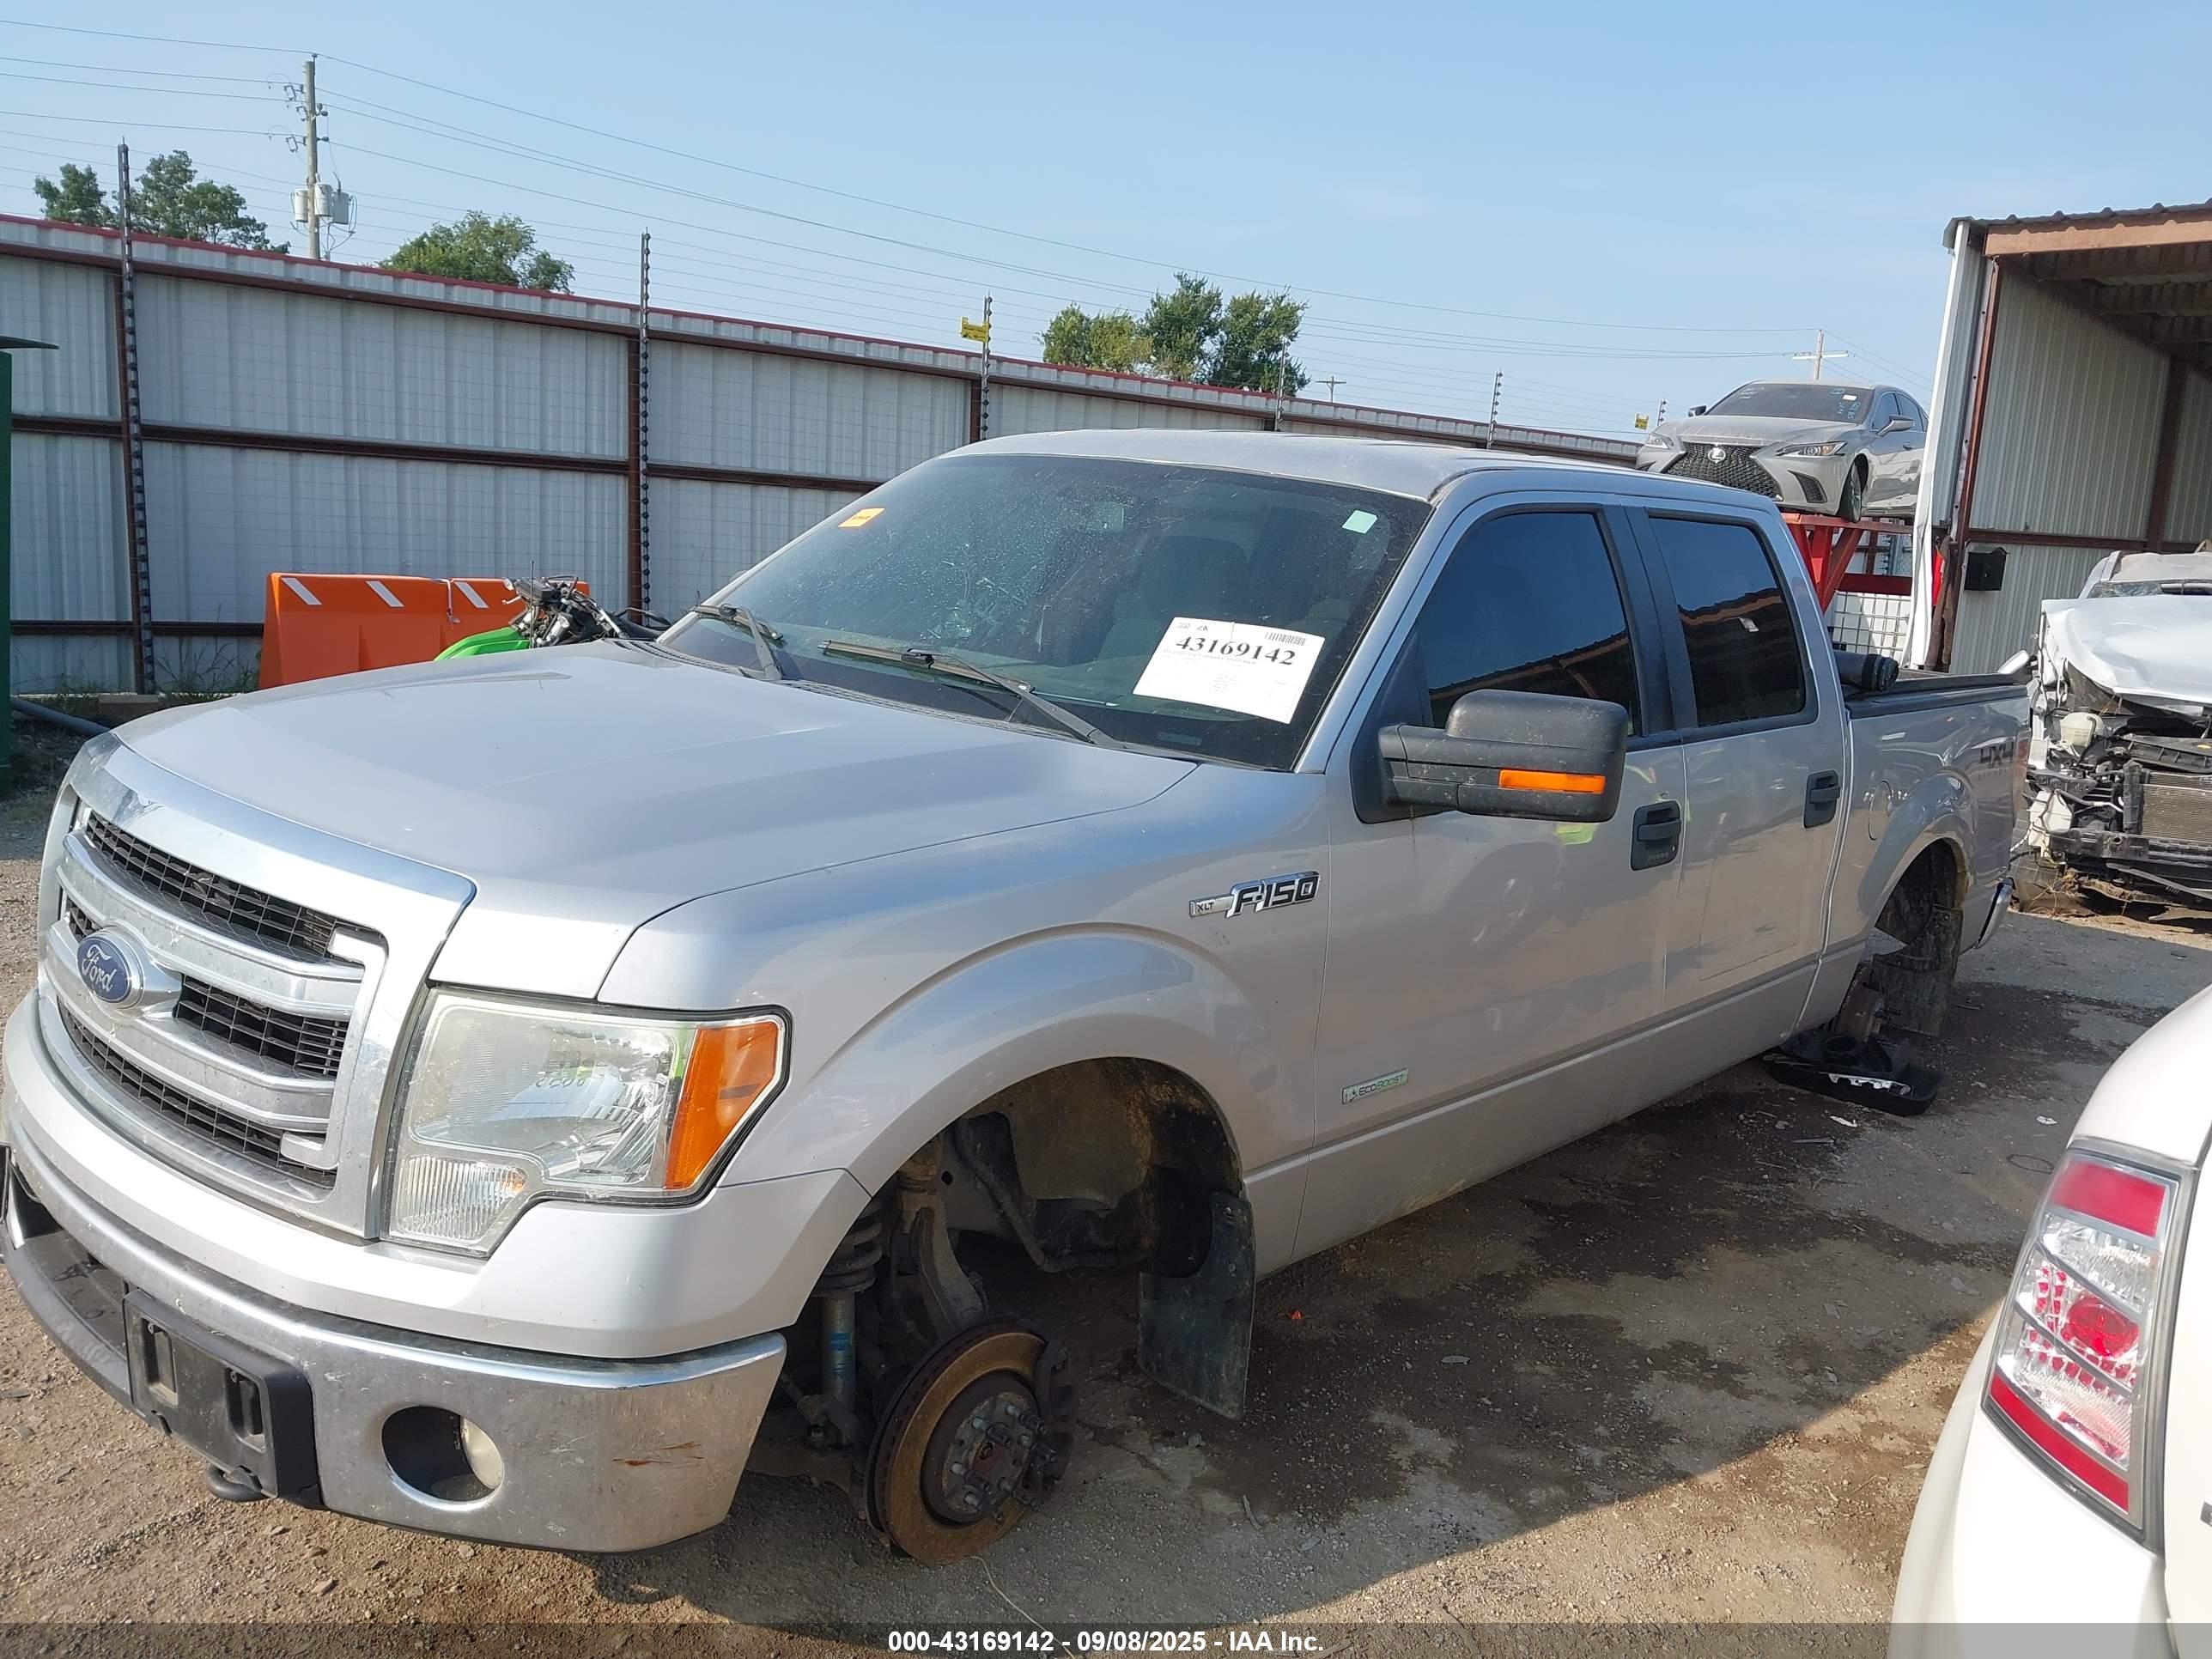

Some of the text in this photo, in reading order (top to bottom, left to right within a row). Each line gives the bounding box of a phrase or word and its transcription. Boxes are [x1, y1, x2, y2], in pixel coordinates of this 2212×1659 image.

[1176, 636, 1296, 665] 43169142
[1196, 901, 1215, 913] XLT
[82, 944, 118, 993] Ford
